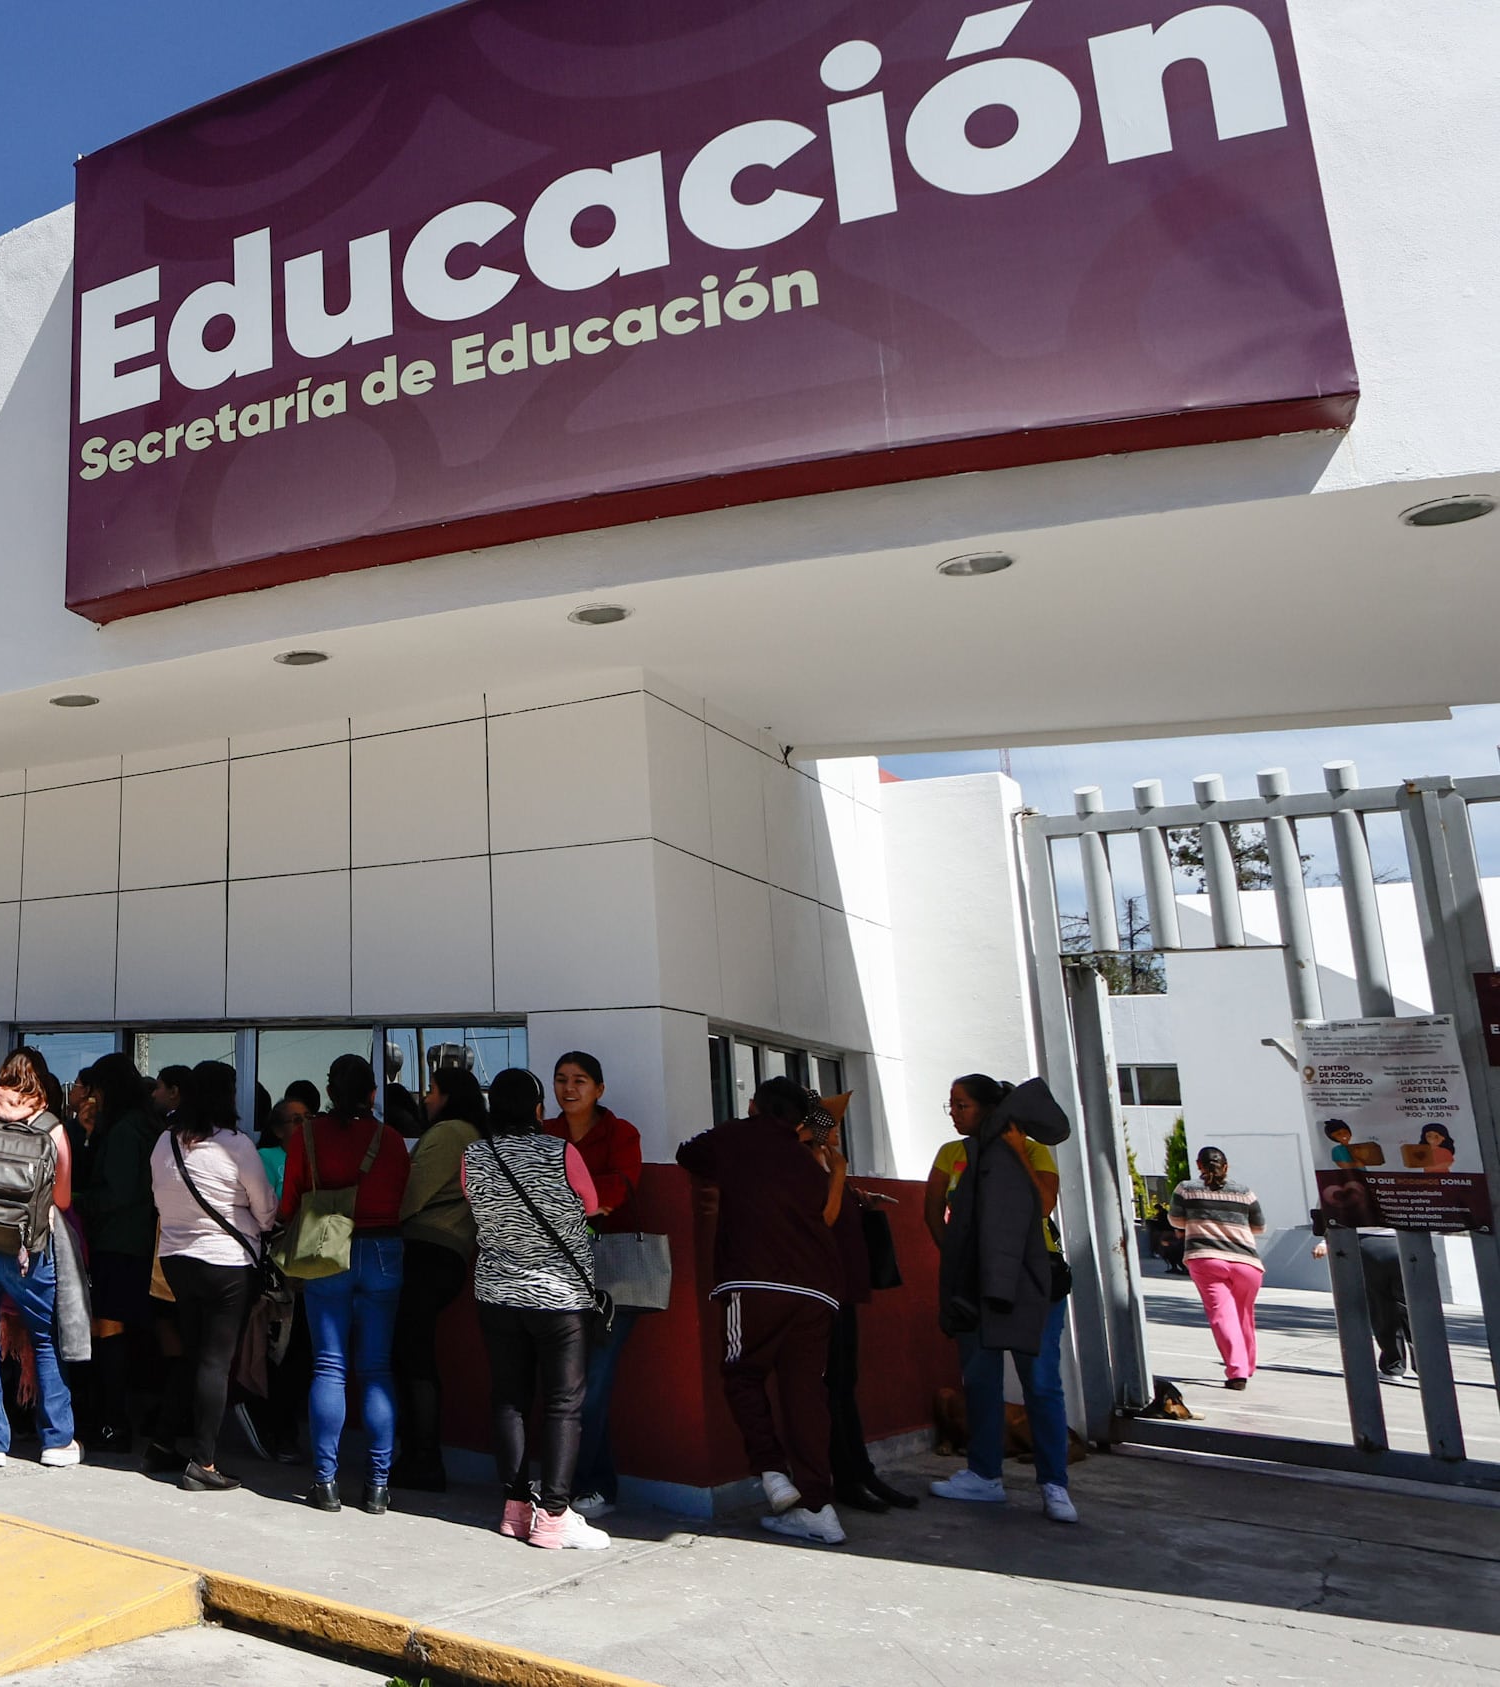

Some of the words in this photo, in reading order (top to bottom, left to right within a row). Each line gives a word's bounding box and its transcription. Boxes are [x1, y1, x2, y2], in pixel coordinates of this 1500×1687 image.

[78, 0, 1288, 424] Educación
[78, 376, 347, 481] Secretaría
[360, 354, 435, 405] de
[451, 265, 819, 386] Educación
[1440, 1178, 1472, 1186] DONAR
